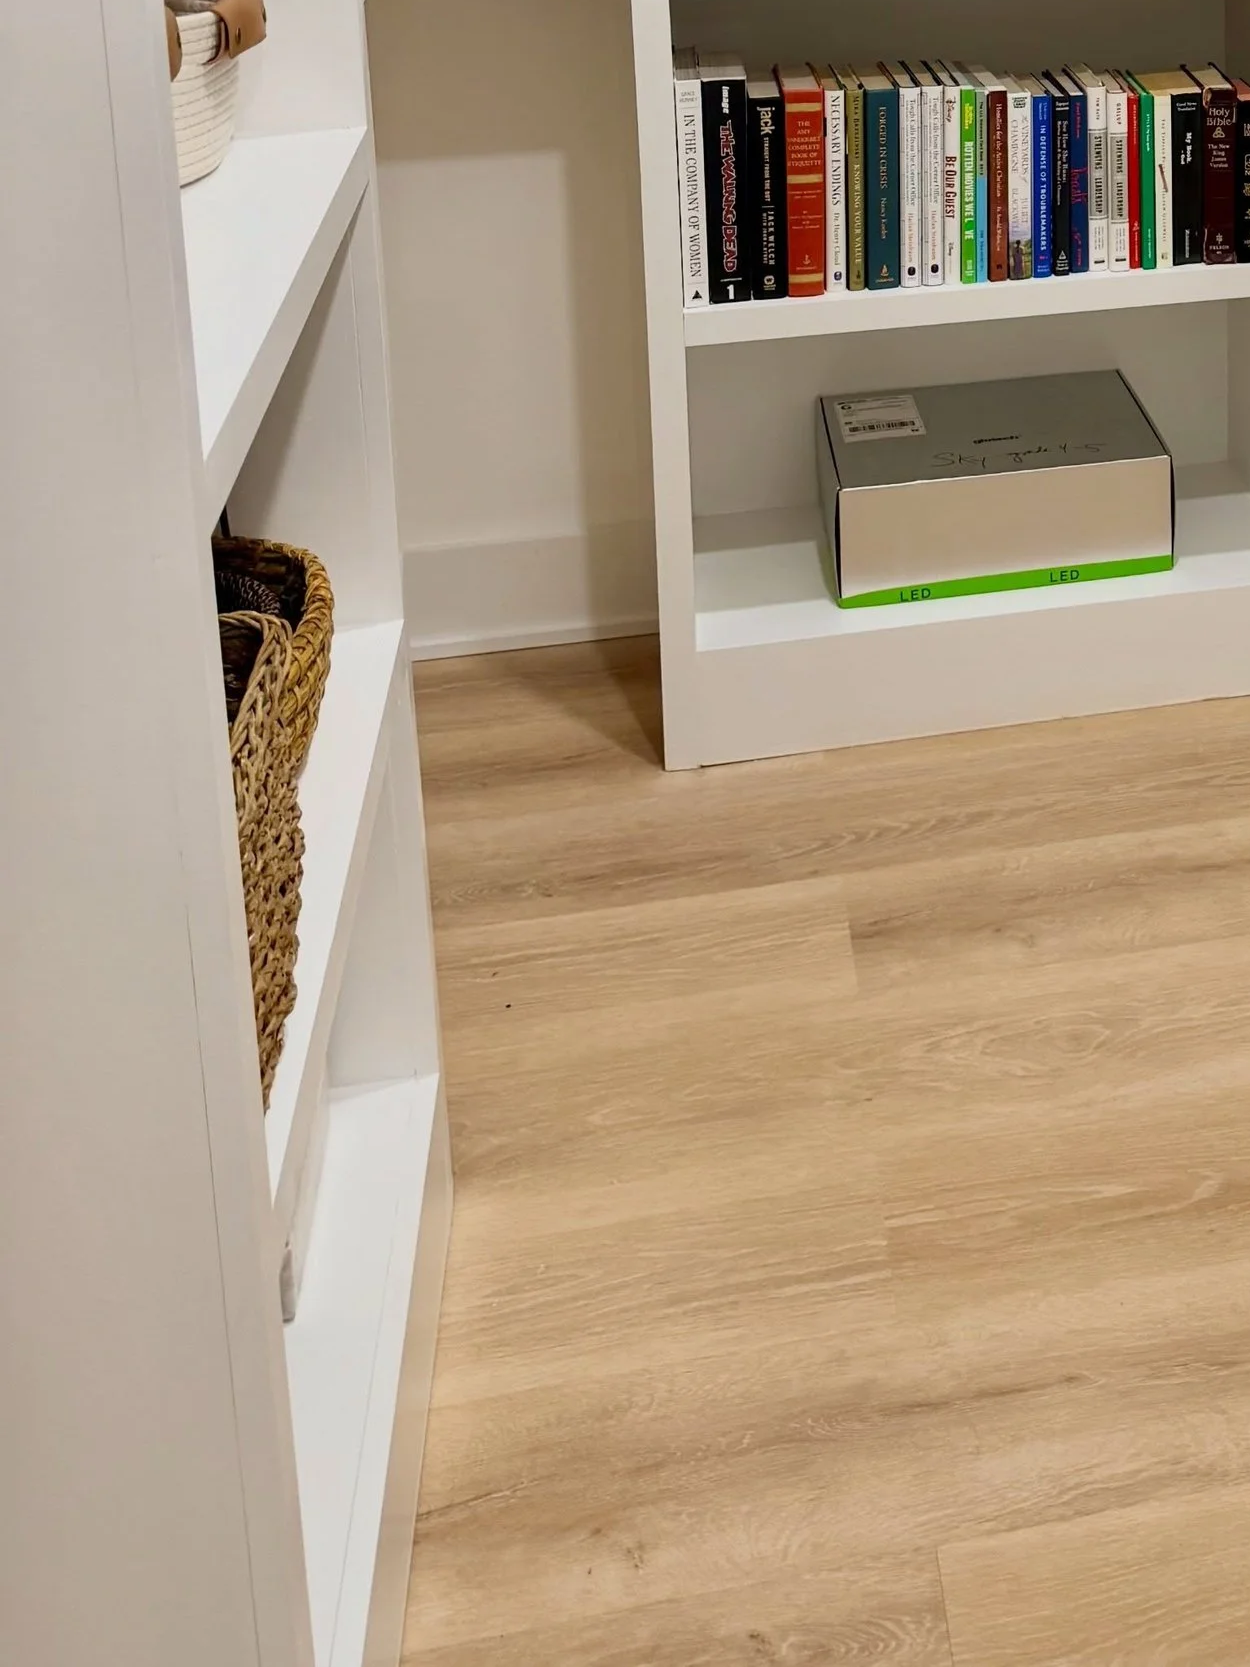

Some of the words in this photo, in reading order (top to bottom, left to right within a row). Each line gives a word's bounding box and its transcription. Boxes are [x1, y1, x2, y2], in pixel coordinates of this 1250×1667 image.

[684, 114, 696, 127] IN
[757, 107, 775, 135] jack
[831, 95, 841, 154] NECESSARY
[879, 106, 888, 143] FORGED
[1206, 117, 1232, 126] Bible
[1209, 108, 1230, 117] Holy
[685, 129, 697, 155] THE
[720, 120, 735, 156] THE
[1040, 125, 1046, 134] IN
[1185, 132, 1192, 143] My
[880, 146, 888, 157] IN
[964, 141, 974, 171] ROTTEN
[1011, 119, 1019, 173] CHAMPAGNE
[1021, 124, 1029, 174] VINEYARDS
[1094, 136, 1102, 170] STRENGTHS
[686, 157, 699, 212] COMPANY
[831, 159, 841, 206] ENDINGS
[880, 160, 888, 189] CRISIS
[964, 172, 974, 202] MOVIES
[1040, 171, 1047, 182] OF
[721, 156, 736, 225] WALKING
[1095, 177, 1103, 214] LEADERSHIP
[1116, 182, 1124, 217] LEADERSHIP
[688, 215, 700, 231] OF
[964, 203, 974, 216] WE
[1021, 198, 1029, 223] JULIET
[689, 233, 701, 277] WOMEN
[722, 225, 737, 272] DEAD
[854, 236, 862, 264] VALUE
[727, 284, 734, 300] 1
[900, 588, 931, 602] LED
[1050, 570, 1080, 582] LED
